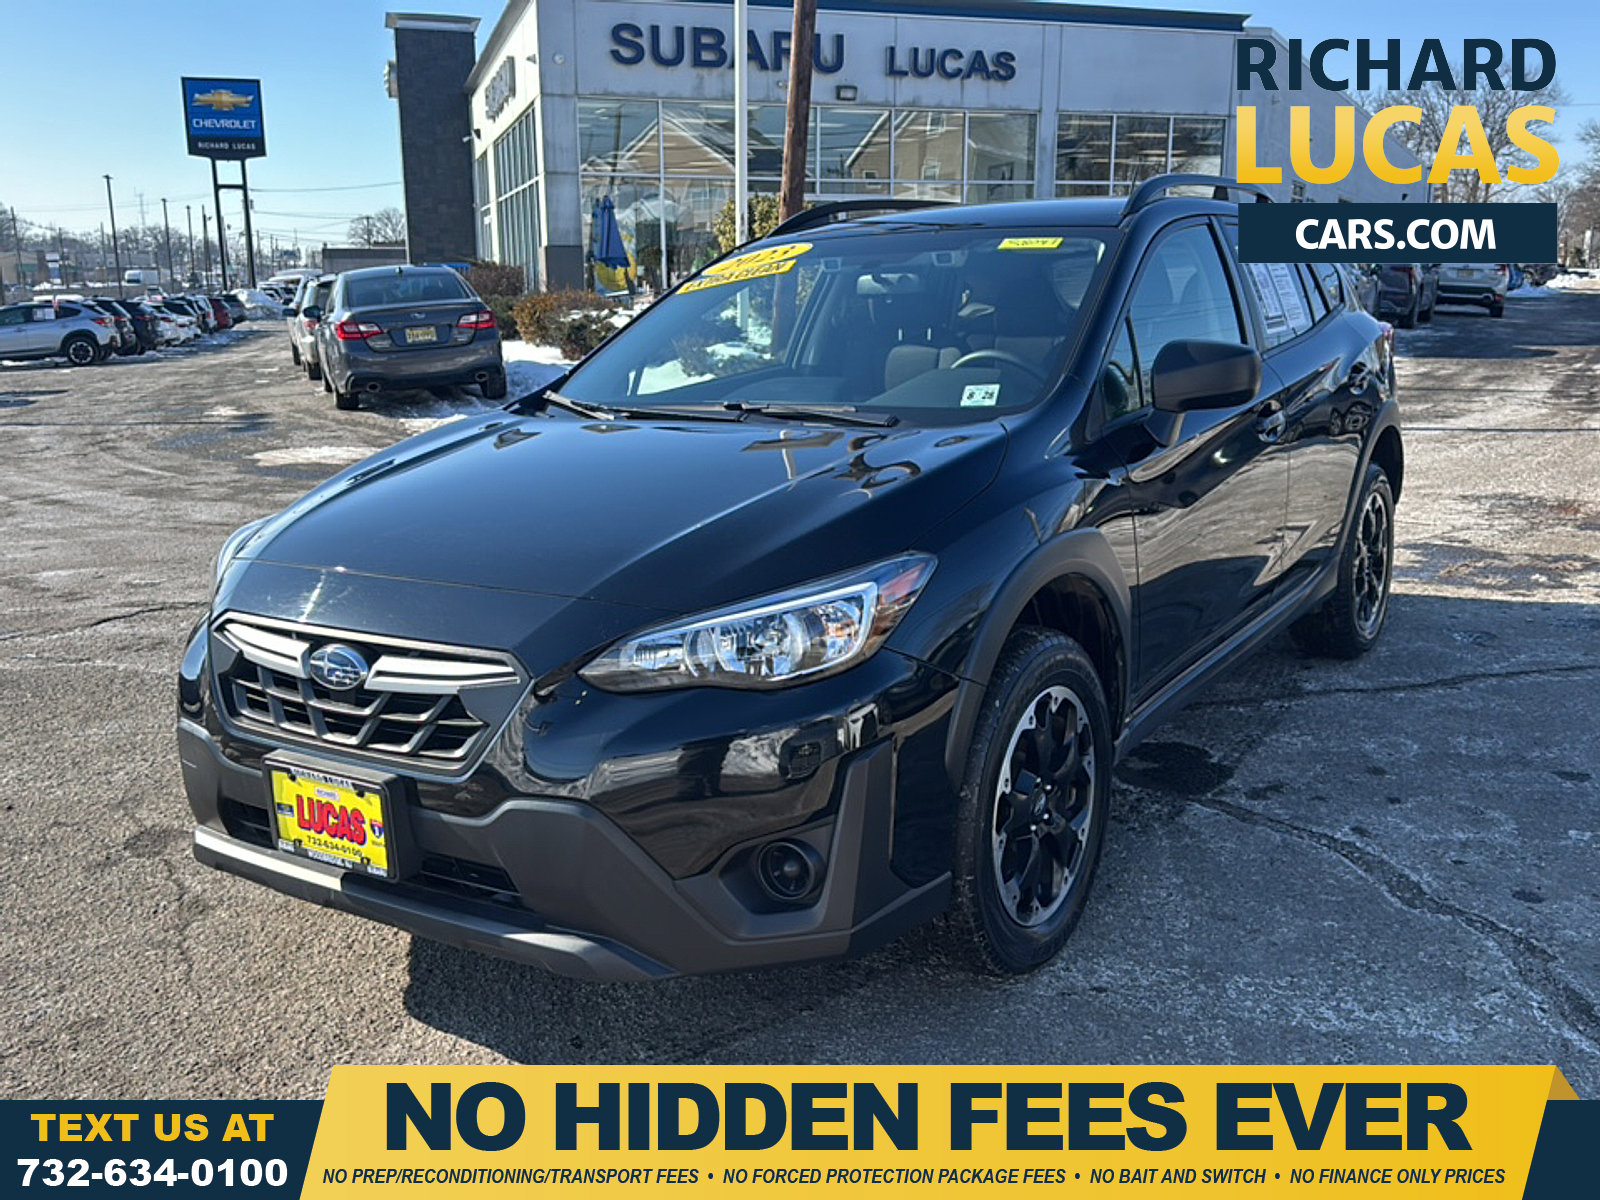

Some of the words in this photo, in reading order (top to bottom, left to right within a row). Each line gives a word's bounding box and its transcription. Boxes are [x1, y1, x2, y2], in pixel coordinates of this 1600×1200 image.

[885, 46, 1017, 81] LUCAS
[193, 119, 256, 129] CHEVROLET
[296, 794, 367, 846] LUCAS
